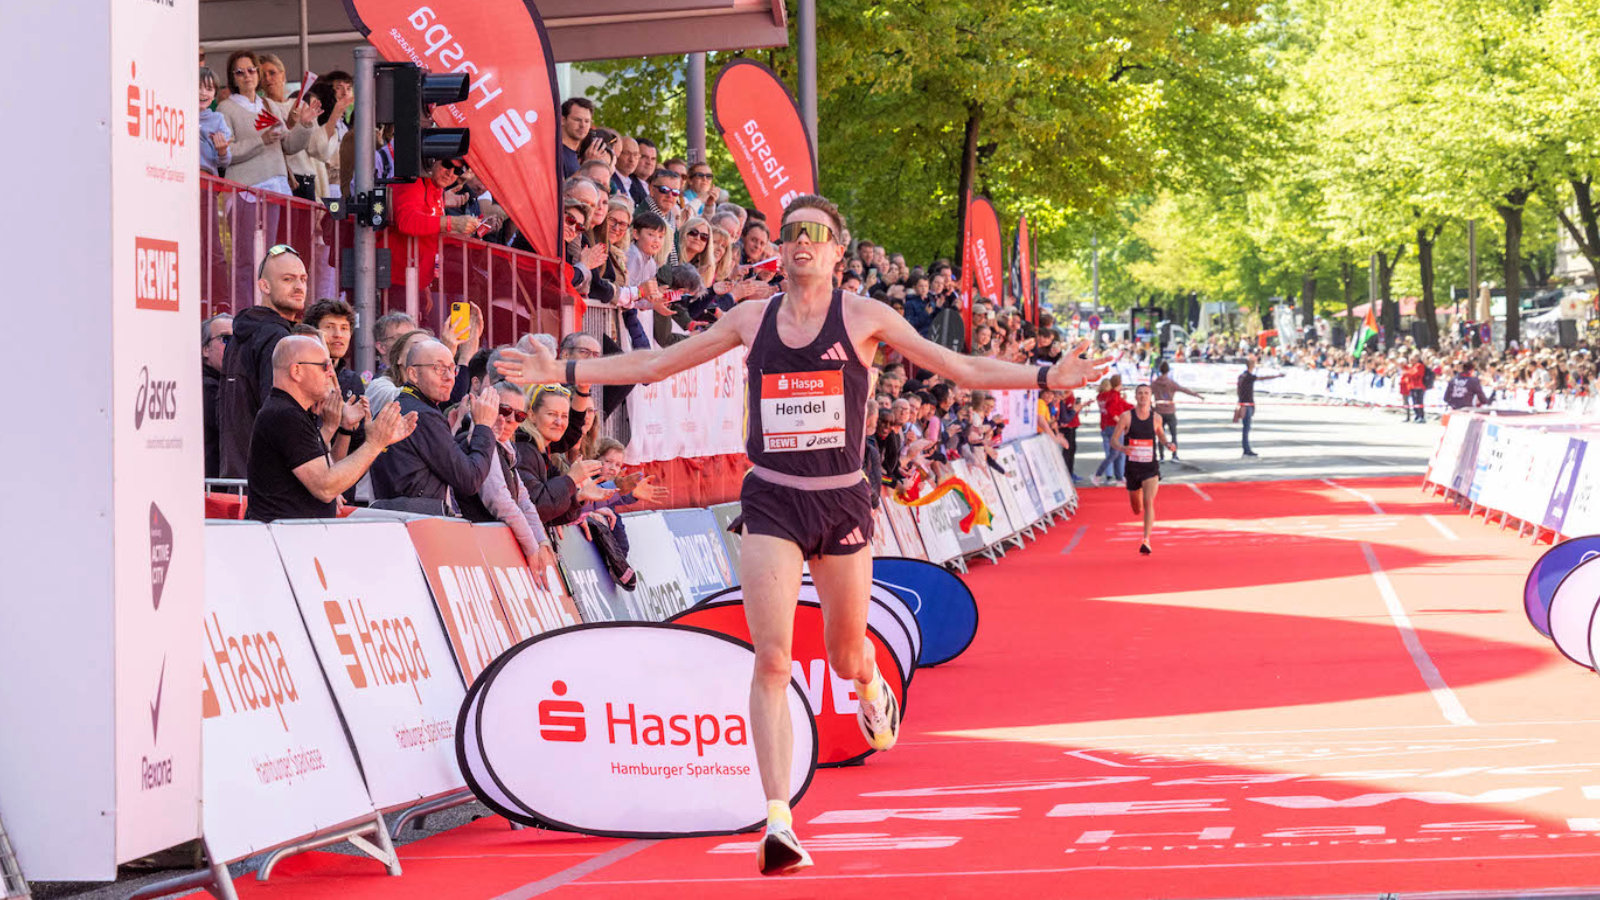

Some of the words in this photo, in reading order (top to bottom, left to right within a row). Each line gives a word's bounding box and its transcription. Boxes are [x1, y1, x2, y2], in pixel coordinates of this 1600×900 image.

[145, 89, 185, 158] Haspa
[137, 247, 178, 302] REWE
[791, 378, 824, 391] Haspa
[775, 400, 826, 416] Hendel
[769, 437, 797, 449] REWE
[203, 612, 299, 732] Haspa
[349, 598, 431, 706] Haspa
[606, 702, 748, 757] Haspa
[141, 756, 172, 790] Rexona
[611, 762, 684, 779] Hamburger
[686, 762, 751, 778] Sparkasse
